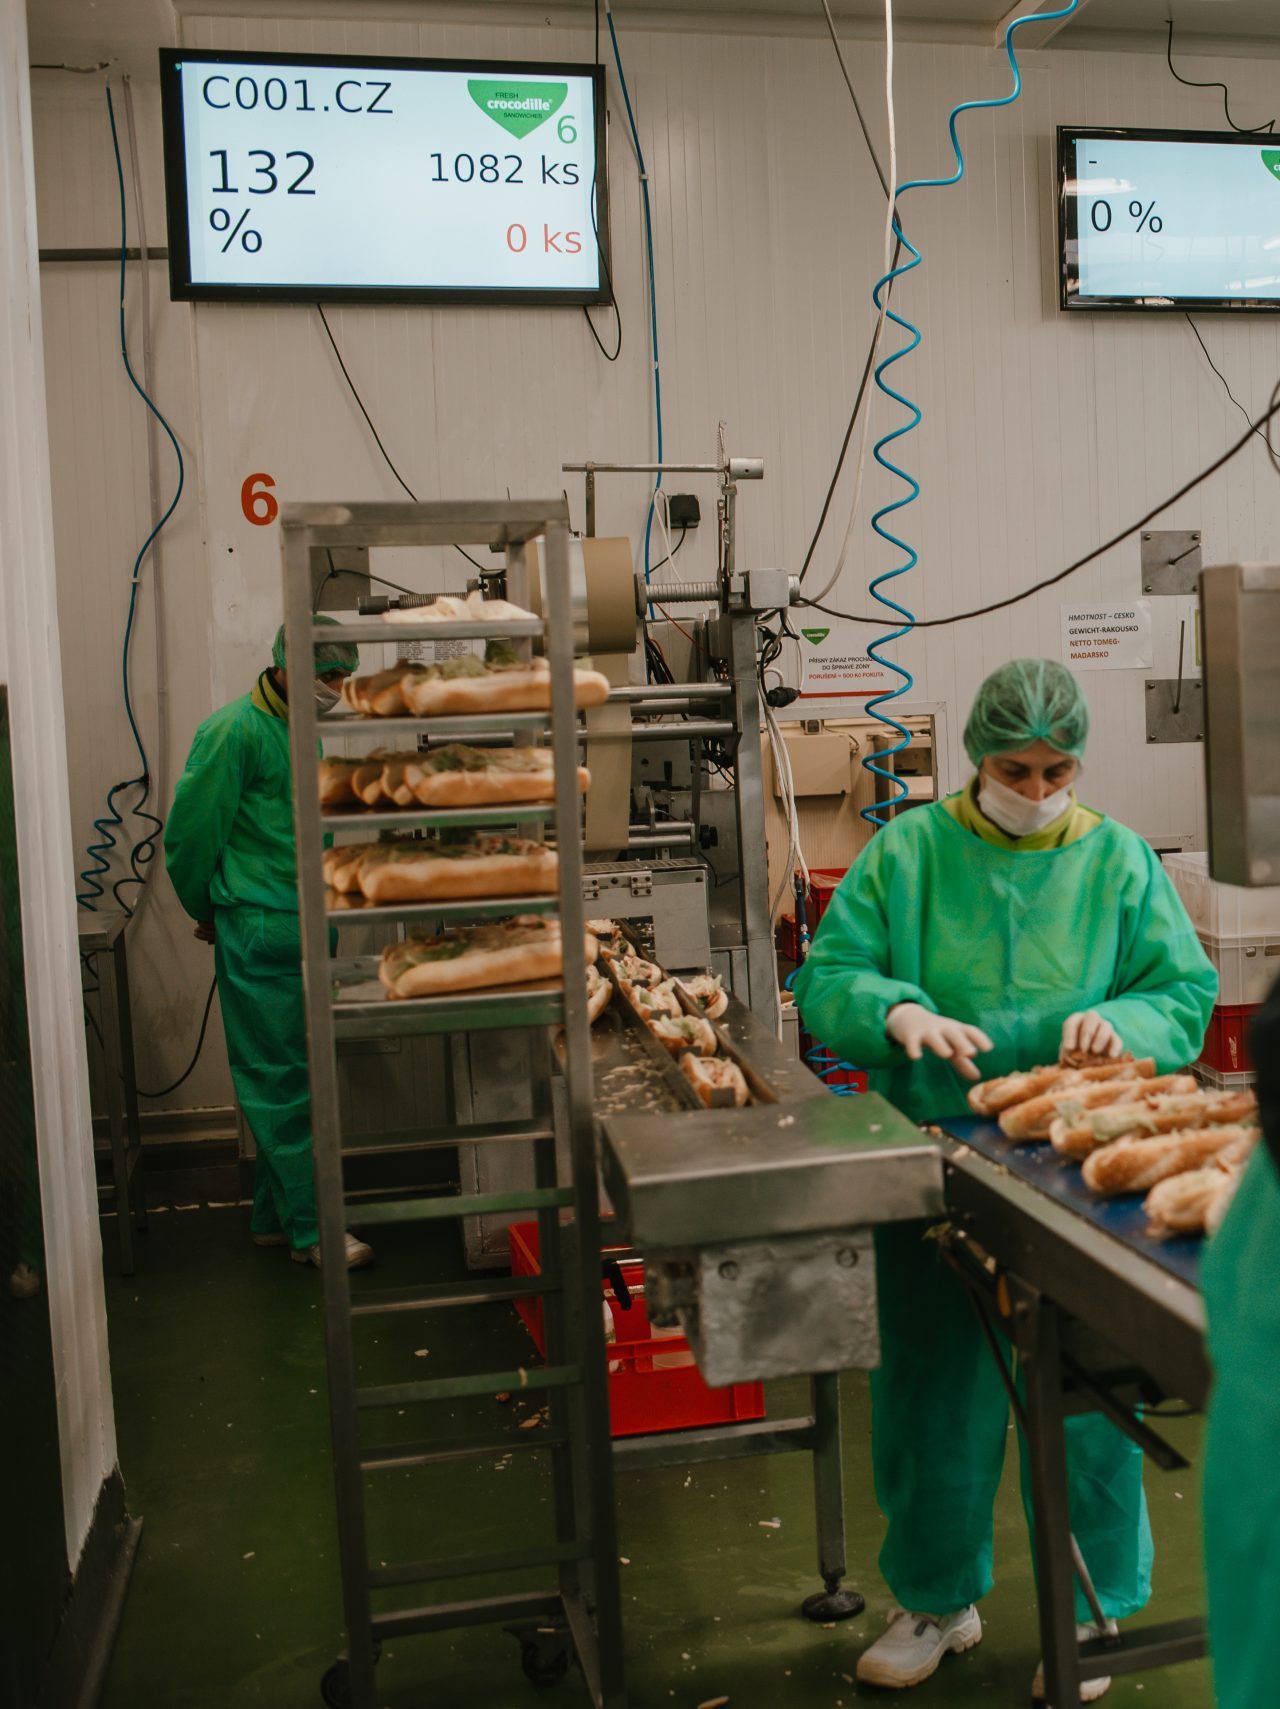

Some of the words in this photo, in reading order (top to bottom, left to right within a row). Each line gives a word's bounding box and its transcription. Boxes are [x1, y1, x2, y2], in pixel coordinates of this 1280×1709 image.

[202, 76, 394, 114] C001.CZ
[487, 98, 550, 111] crocodille
[557, 115, 577, 144] 6
[209, 149, 316, 195] 132
[430, 153, 524, 184] 1082
[541, 155, 580, 186] ks
[209, 207, 263, 254] %
[1091, 200, 1112, 232] 0
[1128, 200, 1163, 233] %
[506, 223, 528, 254] 0
[543, 223, 582, 254] ks
[241, 473, 278, 526] 6
[1068, 613, 1107, 621] HMOTNOST
[1069, 639, 1092, 647] NETTO
